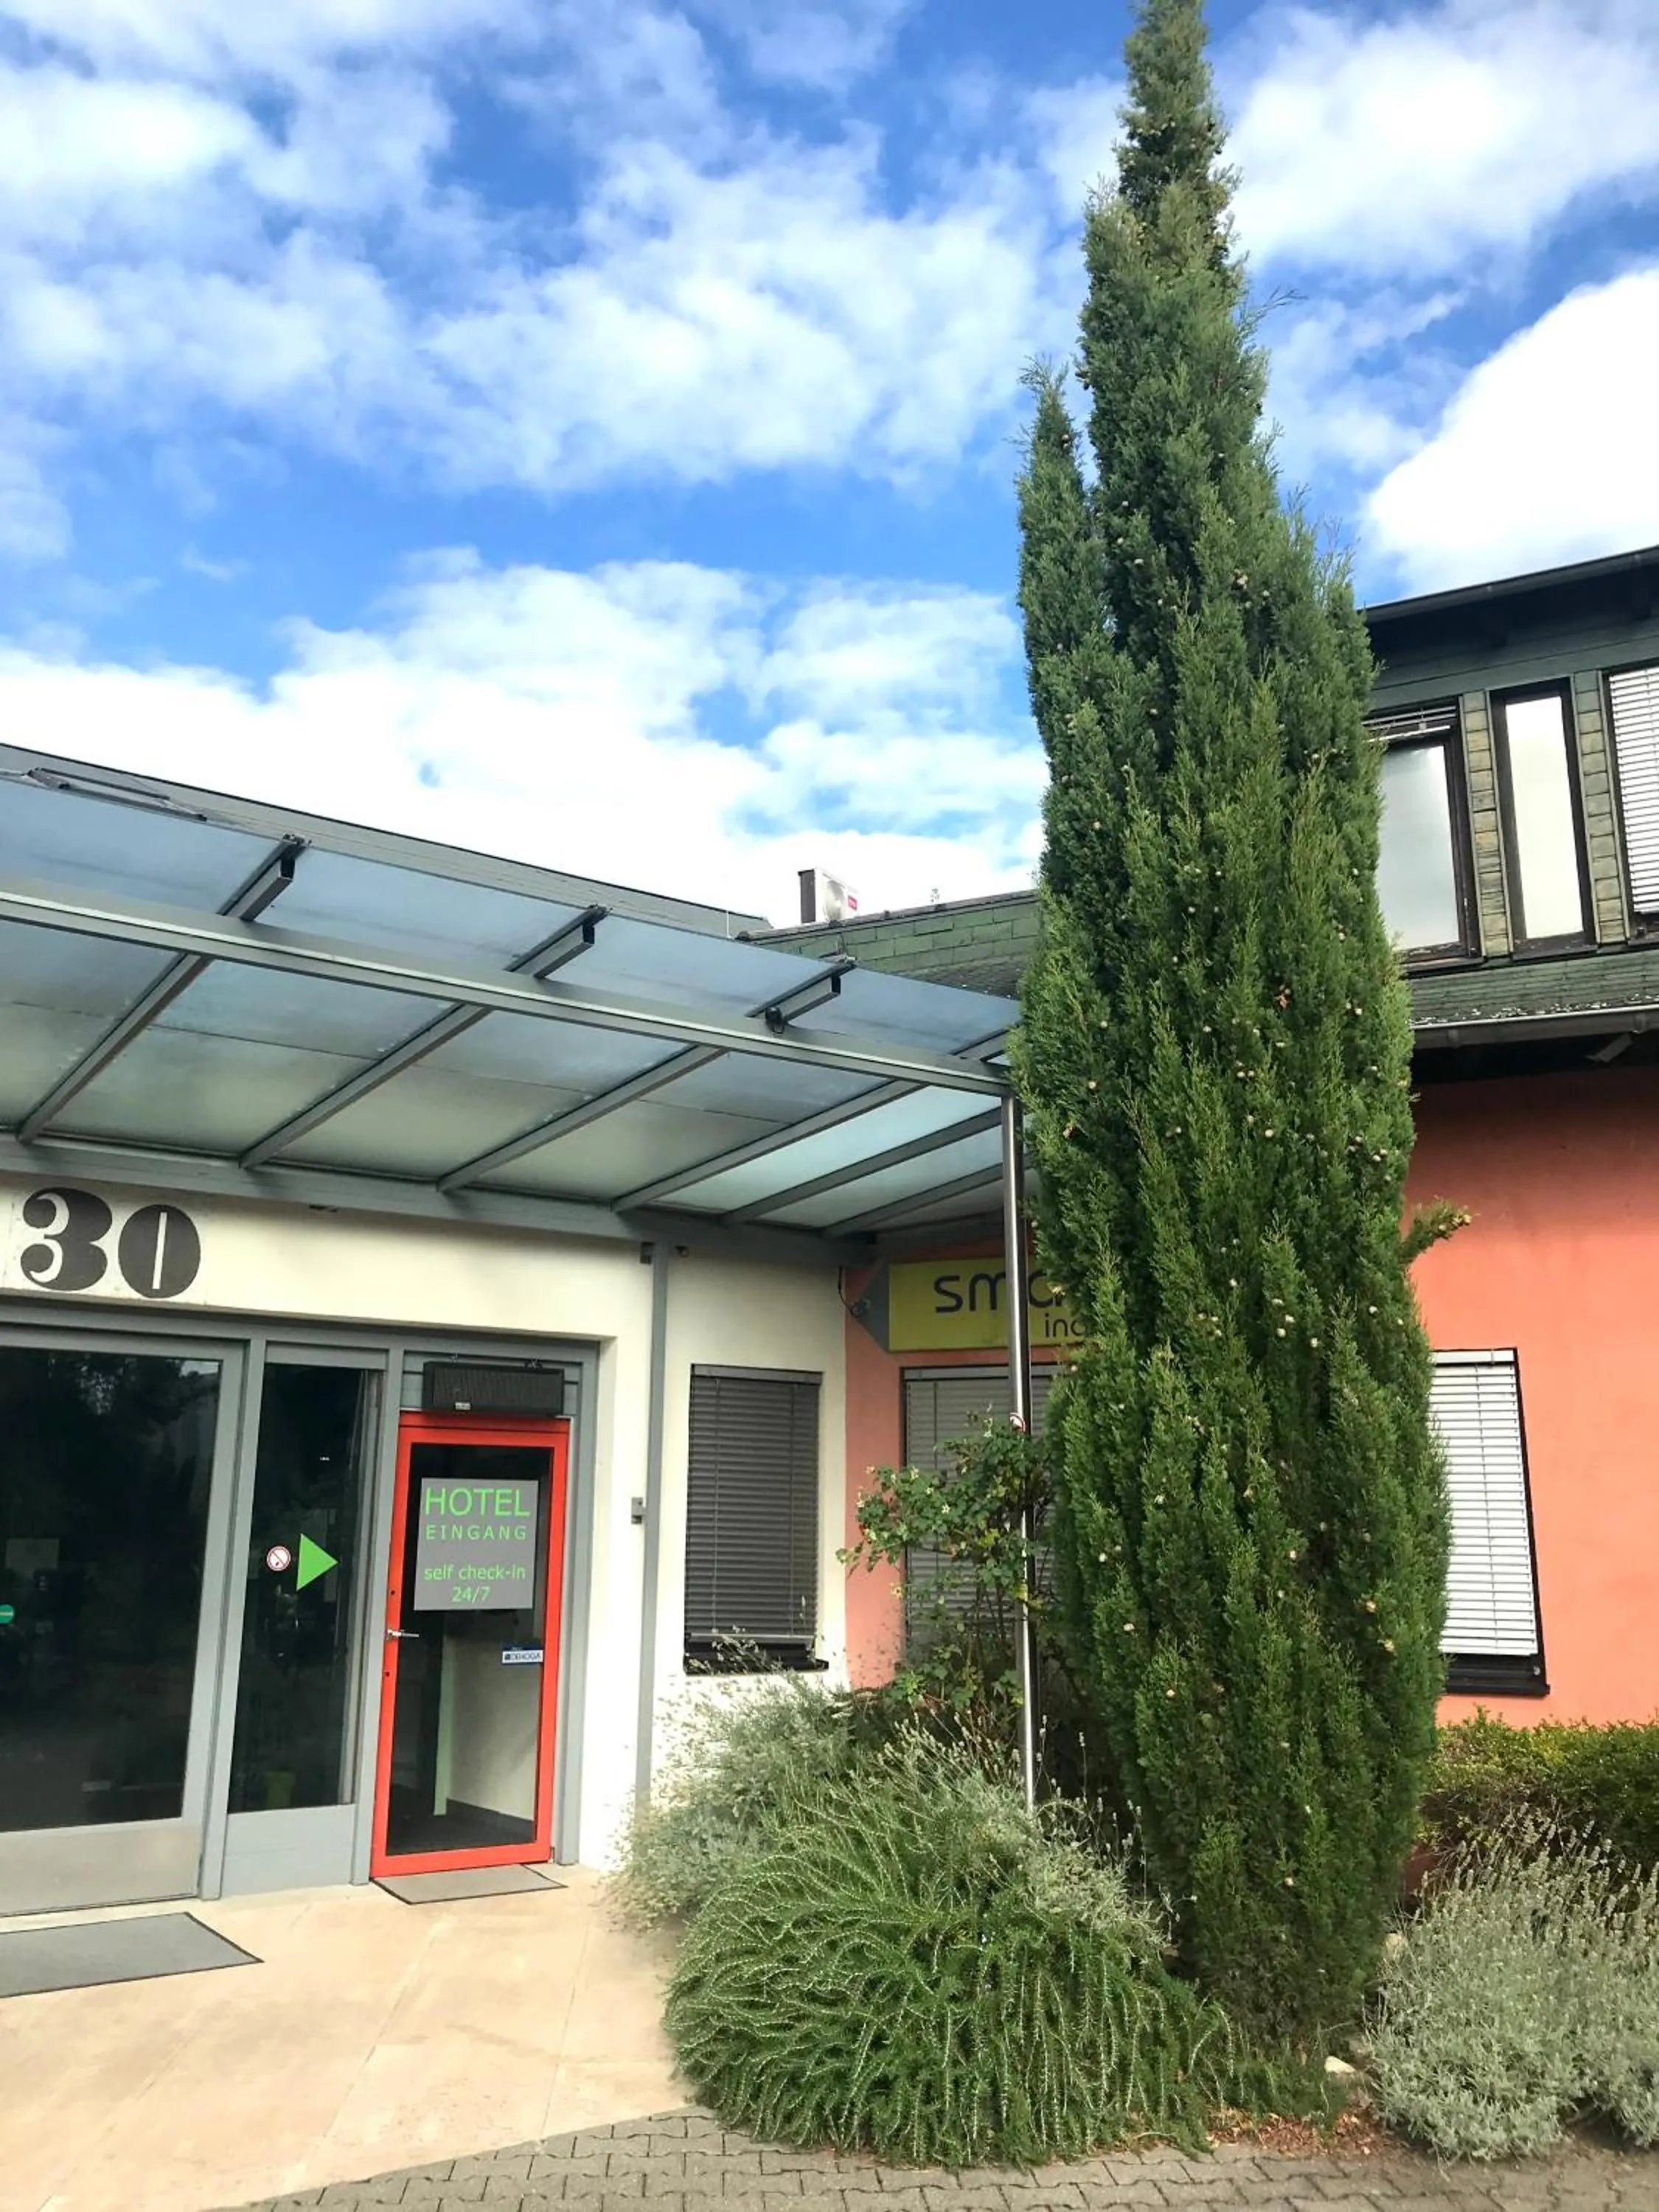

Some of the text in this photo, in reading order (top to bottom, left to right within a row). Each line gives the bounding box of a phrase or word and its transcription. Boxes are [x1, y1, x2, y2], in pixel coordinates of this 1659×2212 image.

[21, 1187, 201, 1298] 30
[425, 1486, 531, 1517] HOTEL
[425, 1523, 527, 1541] EINGANG
[424, 1563, 526, 1580] self check-in
[451, 1585, 491, 1604] 24/7
